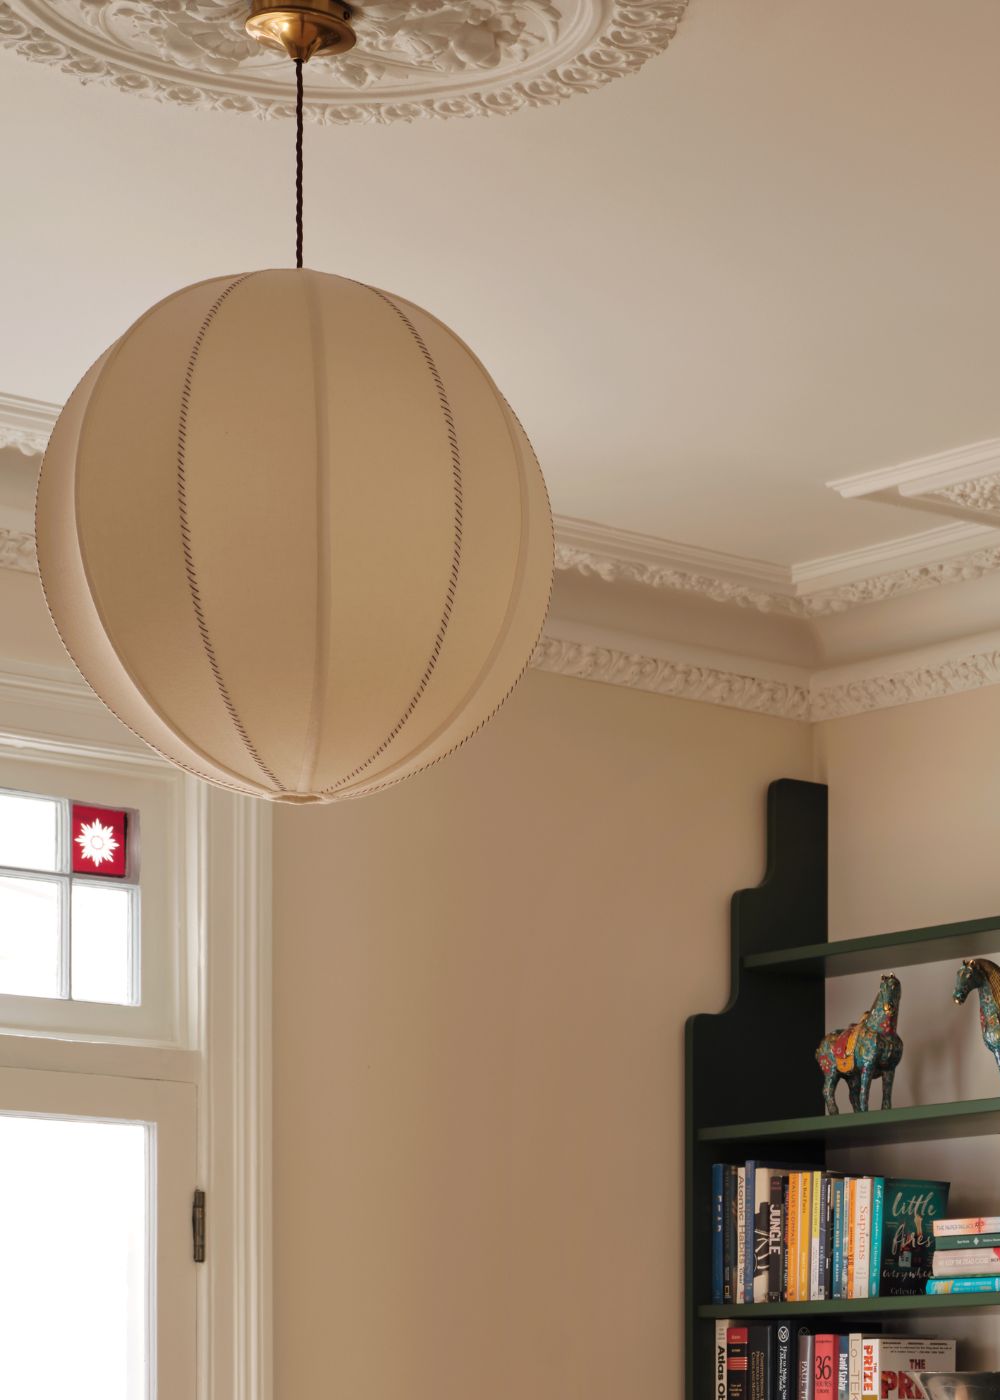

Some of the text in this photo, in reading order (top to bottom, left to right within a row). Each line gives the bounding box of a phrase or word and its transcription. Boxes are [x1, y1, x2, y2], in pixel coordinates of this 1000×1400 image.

[892, 1192, 936, 1216] little
[769, 1204, 781, 1255] JUNGLE
[857, 1206, 868, 1260] Sapiens
[891, 1223, 931, 1255] fires
[718, 1345, 726, 1380] Atlas
[800, 1361, 808, 1386] PAUL
[816, 1356, 831, 1380] 36
[839, 1353, 848, 1391] David Szalay
[864, 1345, 873, 1391] PRIZE
[909, 1359, 926, 1370] THE
